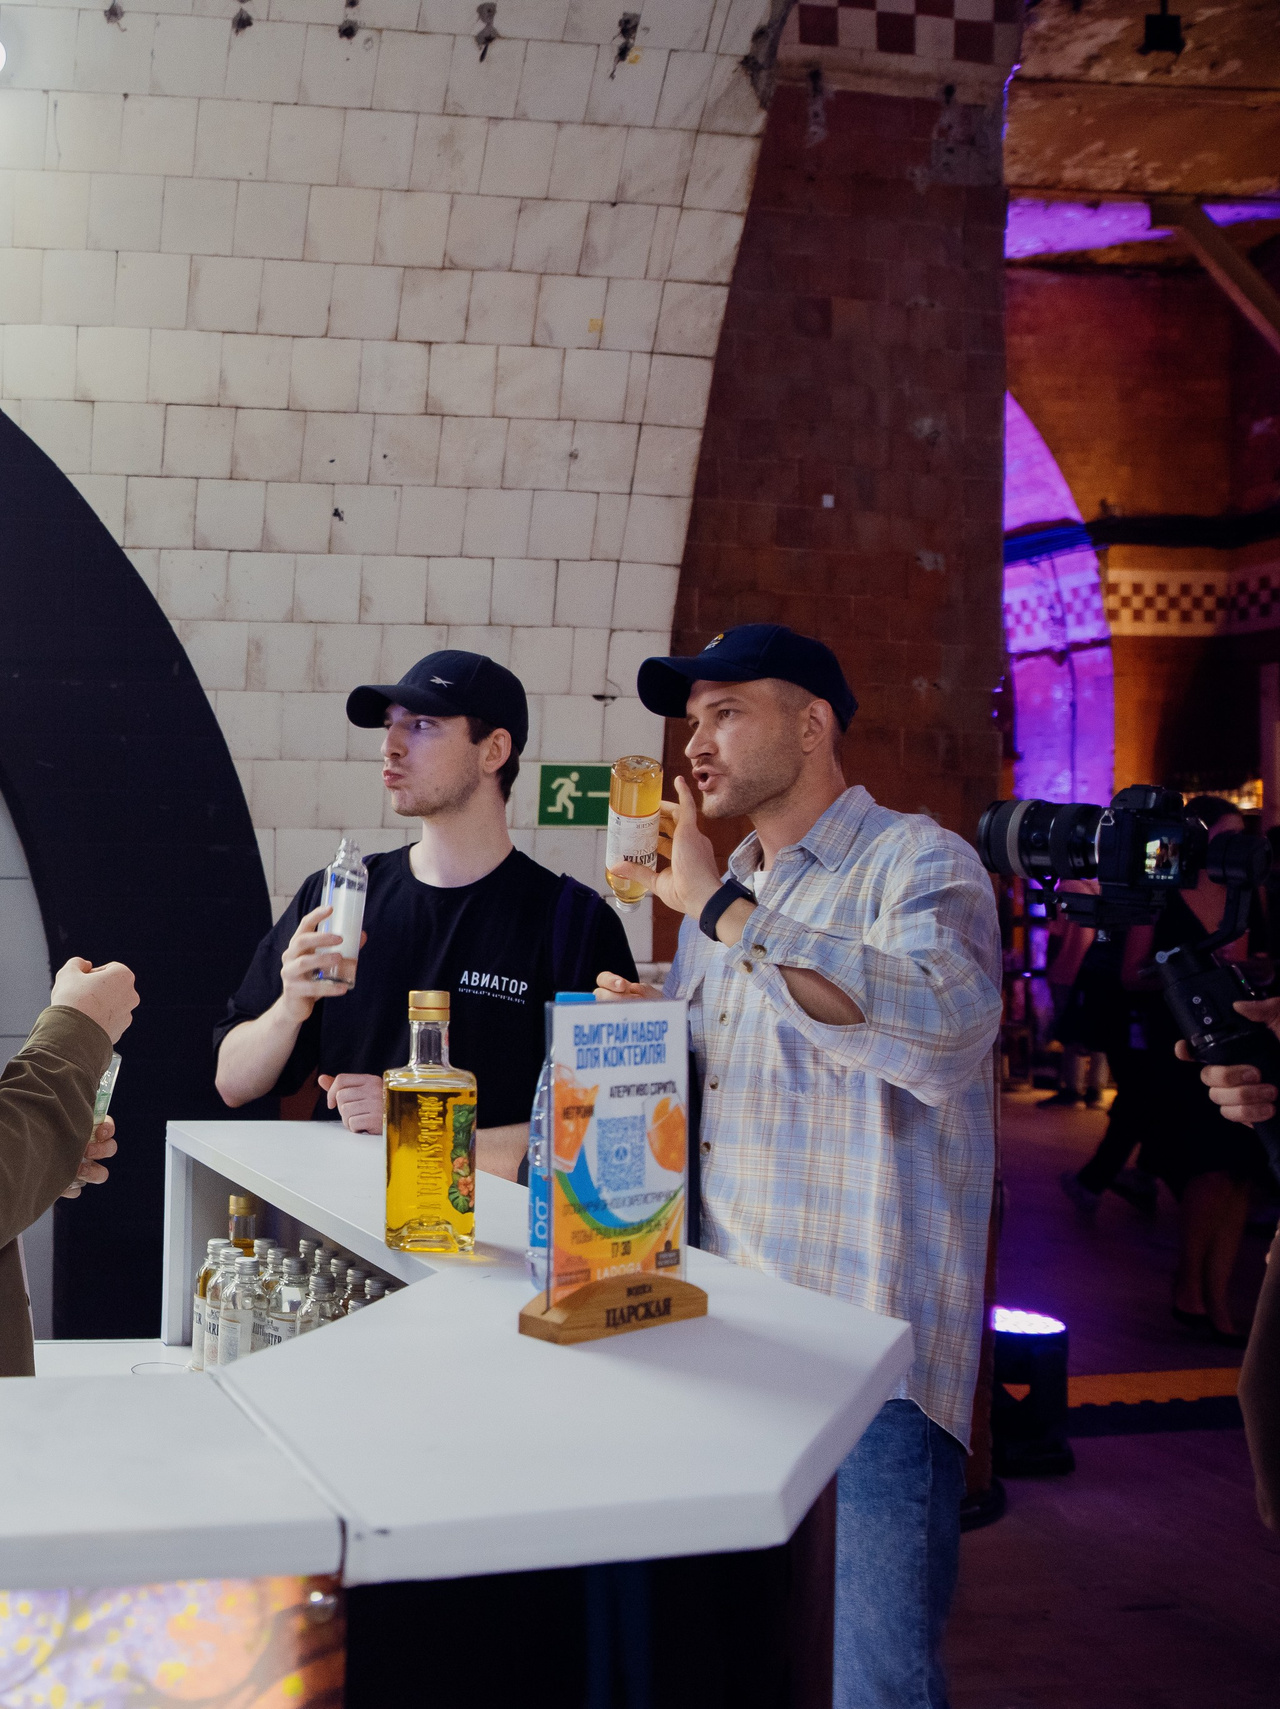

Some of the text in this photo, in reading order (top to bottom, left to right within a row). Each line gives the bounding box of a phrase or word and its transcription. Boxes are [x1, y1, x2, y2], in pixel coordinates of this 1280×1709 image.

[460, 970, 528, 996] АВИАТОР
[573, 1019, 669, 1046] ВЫИГРАЙ НАБОР
[576, 1049, 601, 1070] ДЛЯ
[605, 1298, 672, 1329] ЦАРСКАЯ
